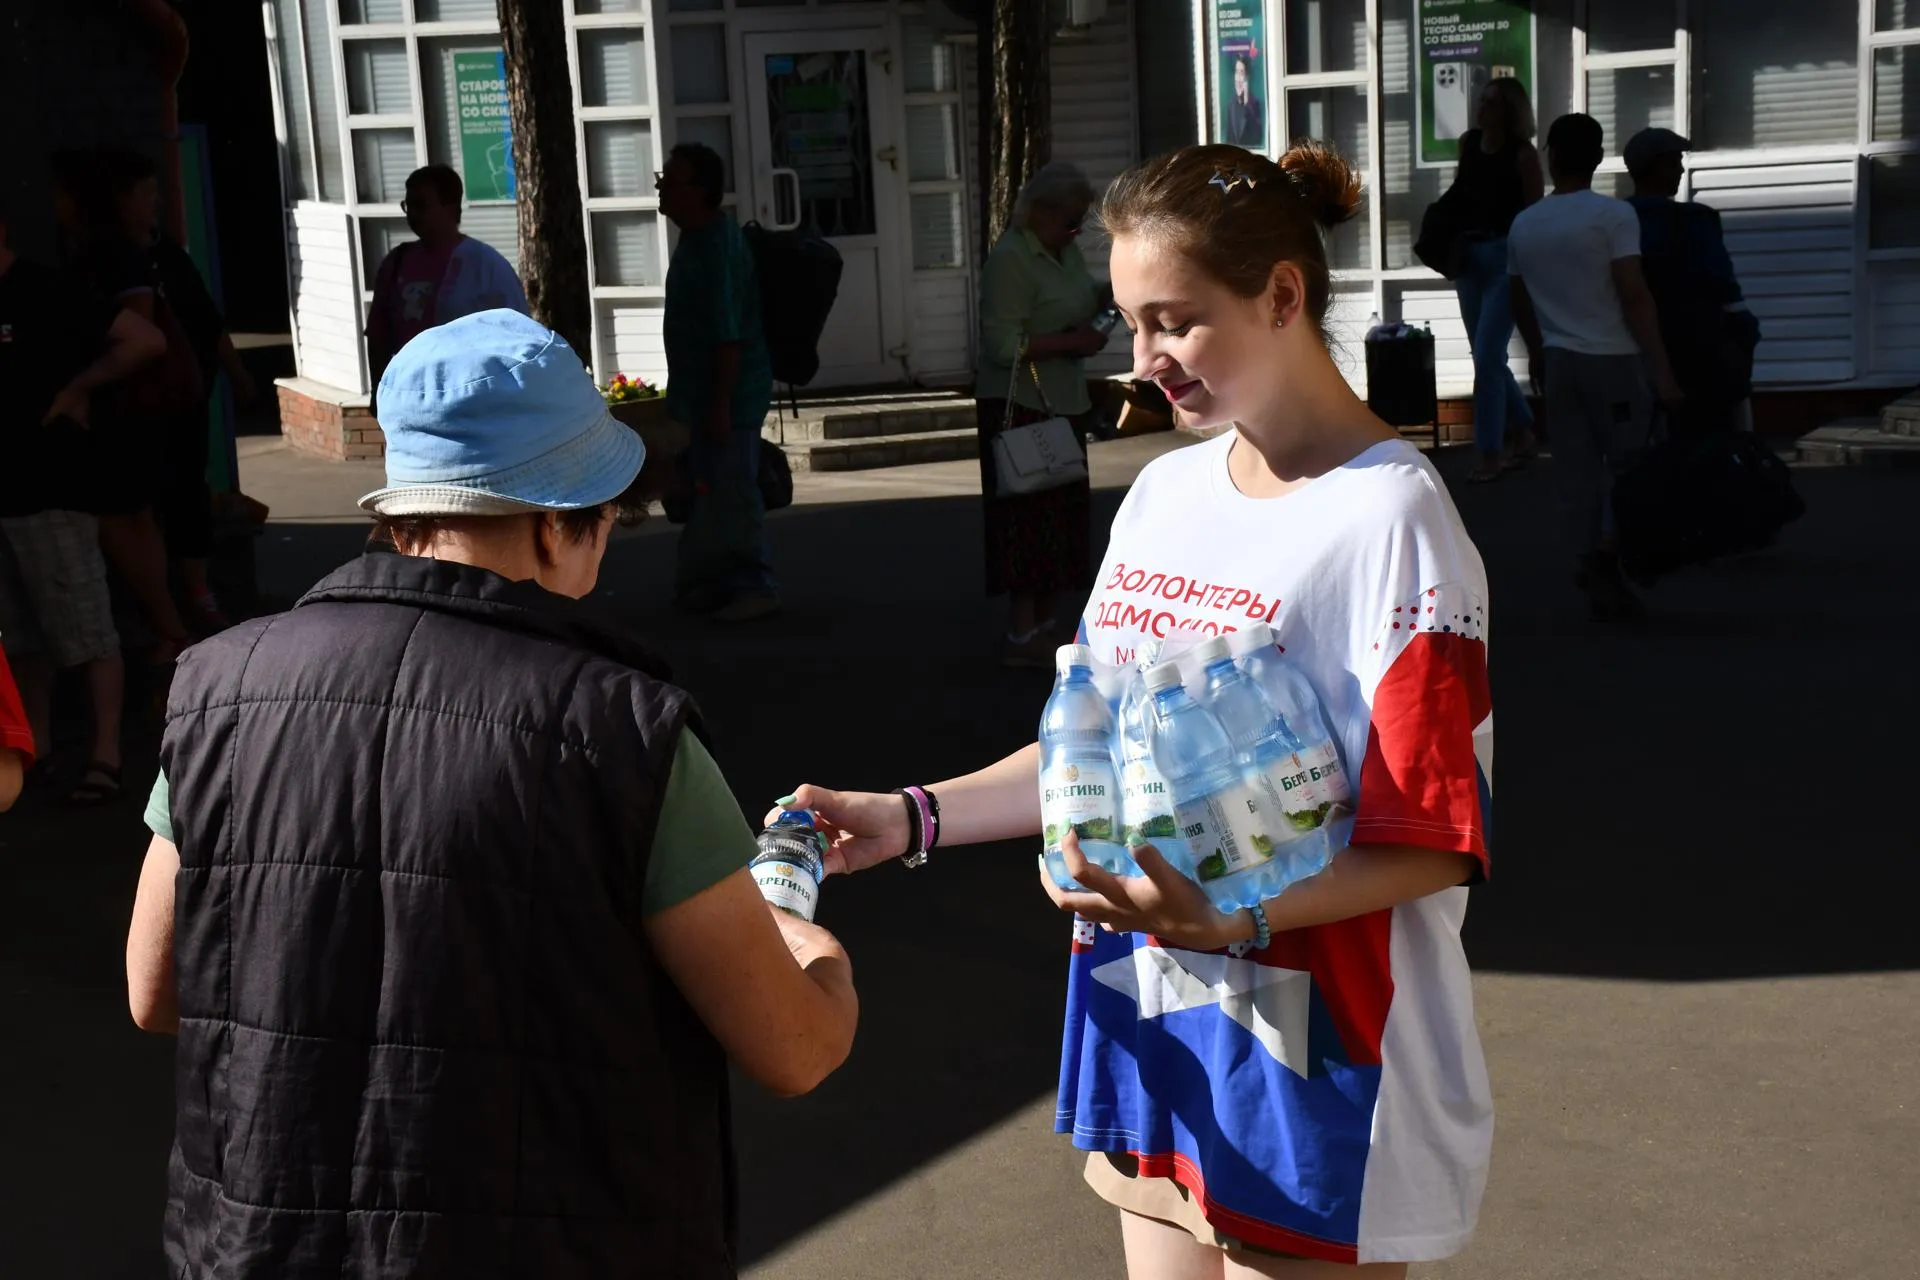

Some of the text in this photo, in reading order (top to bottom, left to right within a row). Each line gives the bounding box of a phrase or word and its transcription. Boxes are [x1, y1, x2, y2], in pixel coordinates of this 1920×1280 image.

[1423, 14, 1460, 26] НОВЫЙ
[1423, 25, 1456, 35] TECNO
[1457, 21, 1495, 33] CAMON
[1423, 32, 1484, 45] СО СВЯЗЬЮ
[461, 93, 478, 105] НА
[462, 105, 511, 118] СО СКИ
[1105, 563, 1282, 624] ВОЛОНТЕРЫ
[1045, 784, 1105, 802] БЕГИНЯ
[757, 876, 811, 903] ЕРЕГИНЯ
